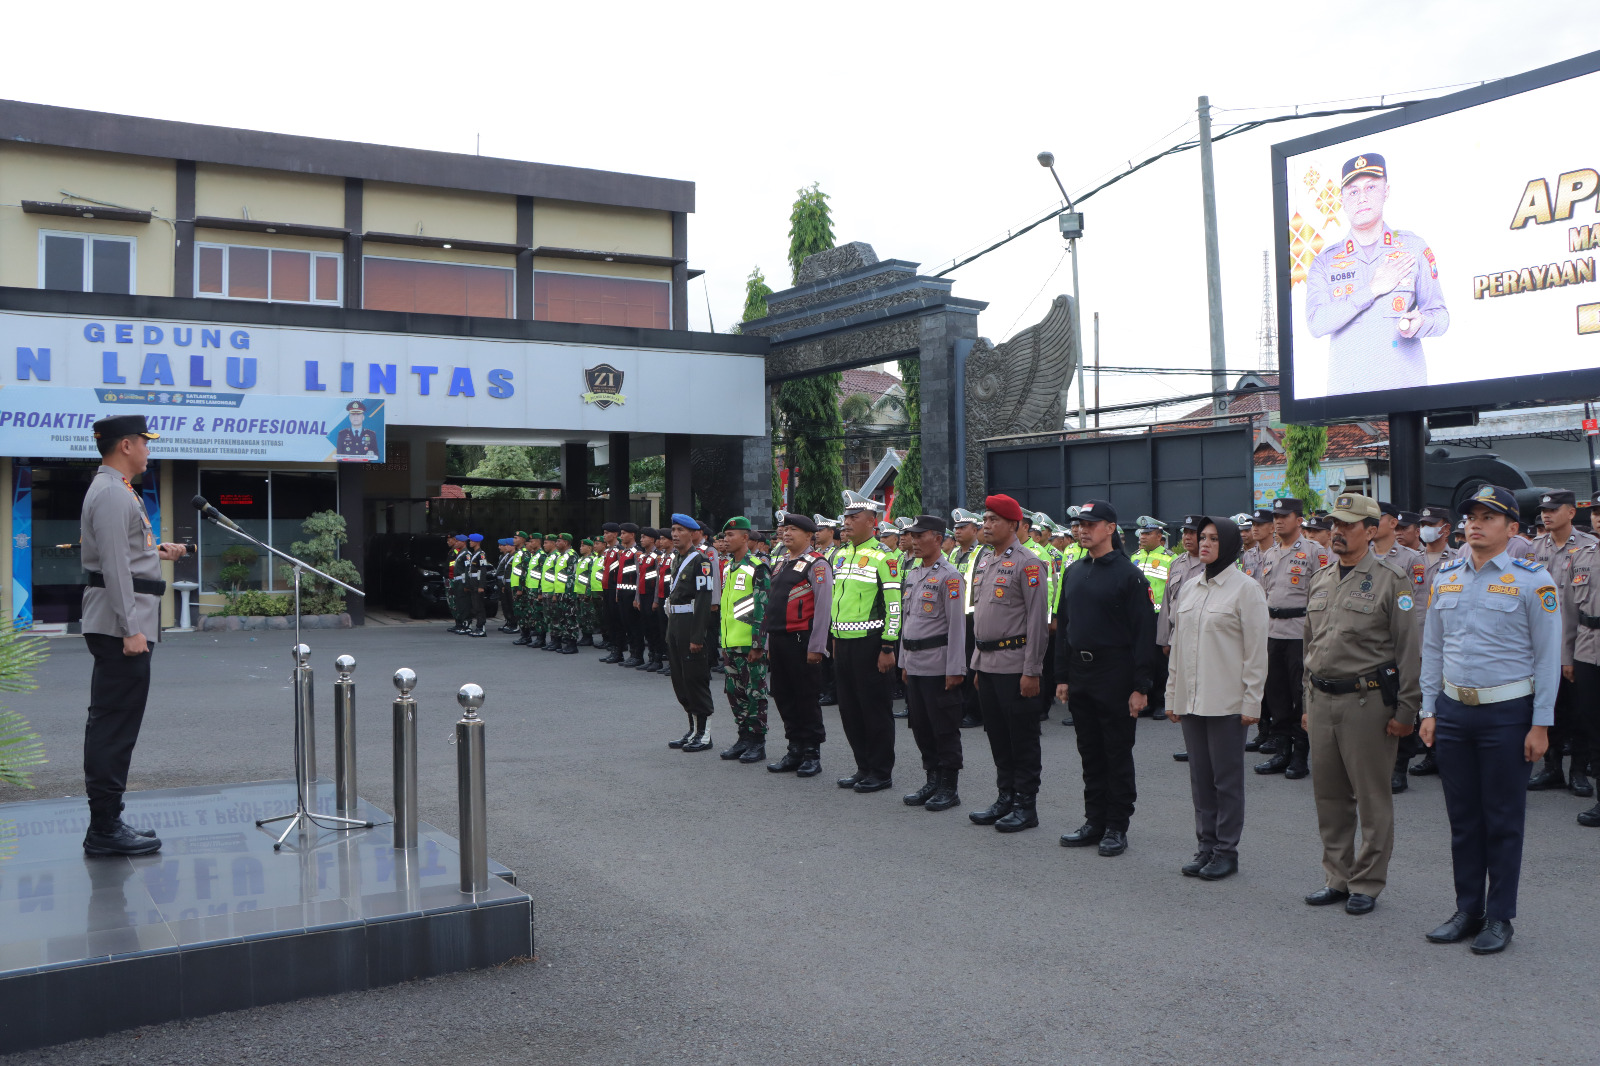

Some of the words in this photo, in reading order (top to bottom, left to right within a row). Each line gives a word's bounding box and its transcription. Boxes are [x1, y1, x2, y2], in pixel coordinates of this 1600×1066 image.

[1510, 168, 1600, 230] AP
[1330, 271, 1356, 282] BOBBY
[1473, 257, 1596, 299] PERAYAAN
[83, 323, 251, 349] GEDUNG
[102, 351, 258, 389] LALU
[304, 360, 515, 399] LINTAS
[594, 372, 615, 387] ZI
[192, 417, 205, 432] &
[211, 417, 329, 435] PROFESIONAL
[50, 434, 72, 442] POLISI
[174, 437, 213, 445] MENGHADAPI
[214, 438, 260, 446] PERKEMBANGAN
[179, 446, 219, 454] MASYARAKAT
[219, 447, 250, 455] TERHADAP
[887, 601, 901, 637] POLISI
